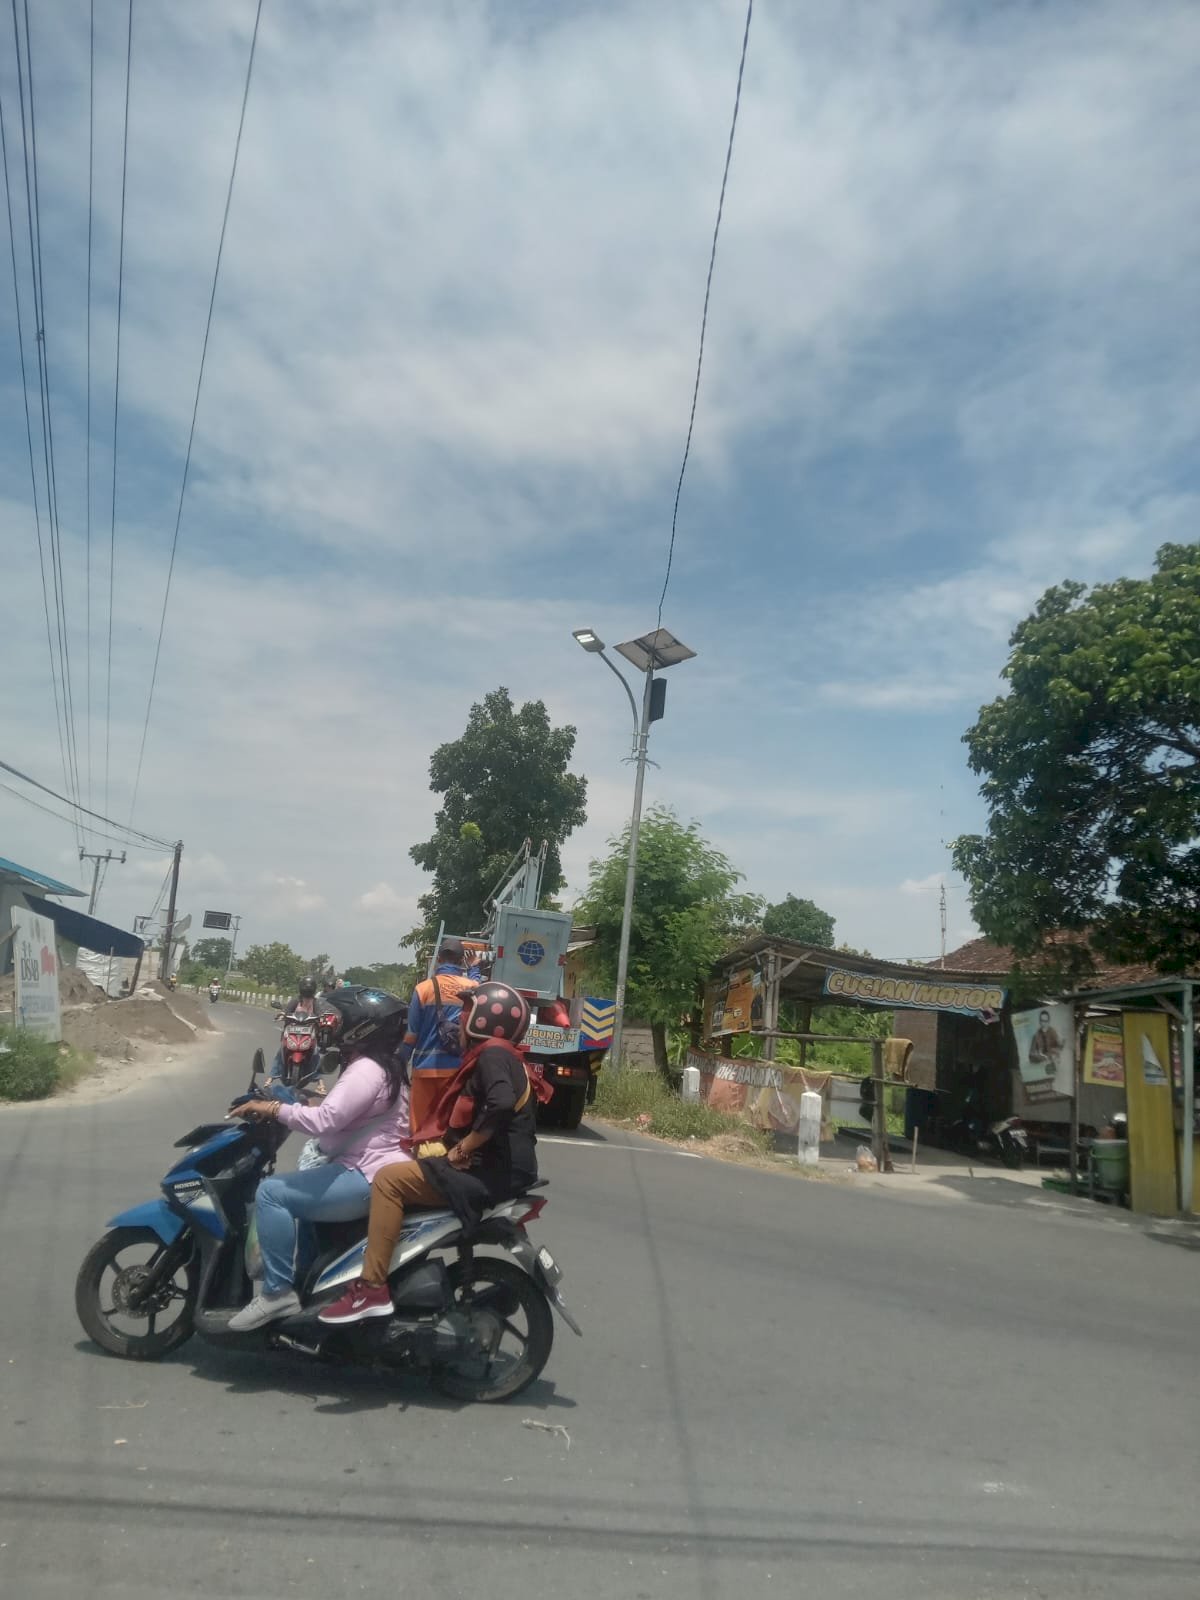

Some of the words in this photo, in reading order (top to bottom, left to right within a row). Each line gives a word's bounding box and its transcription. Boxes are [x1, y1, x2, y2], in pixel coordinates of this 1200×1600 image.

[828, 971, 914, 1001] CUCIAN
[915, 984, 1003, 1009] MOTOR
[174, 1180, 201, 1190] HONDA
